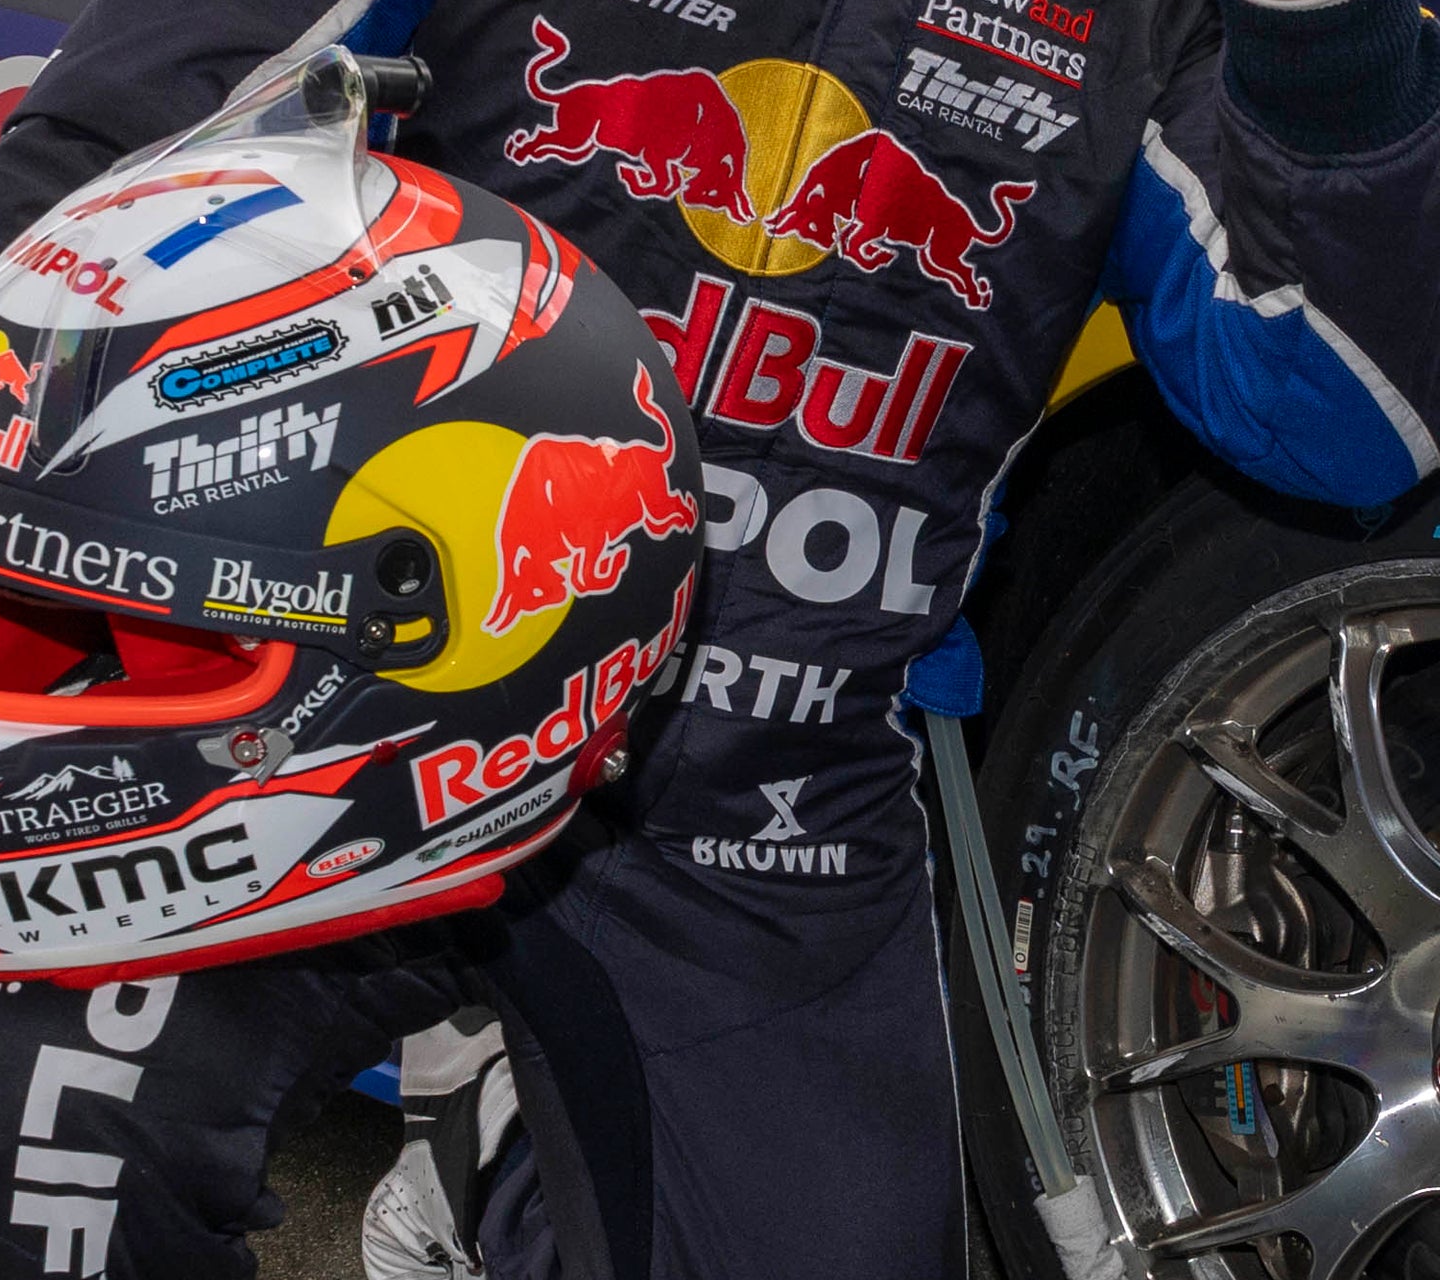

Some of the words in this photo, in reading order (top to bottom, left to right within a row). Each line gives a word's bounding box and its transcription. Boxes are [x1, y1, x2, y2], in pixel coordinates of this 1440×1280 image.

[896, 46, 1080, 153] Thrifty
[896, 91, 936, 120] CAR
[937, 101, 1005, 142] RENTAL
[371, 263, 455, 331] nti
[707, 298, 973, 464] Bull
[143, 402, 342, 500] Thrifty
[153, 490, 200, 515] CAR
[204, 468, 290, 504] RENTAL
[701, 462, 937, 615] POL
[206, 556, 354, 616] Blygold
[202, 608, 273, 627] CORROSION
[275, 618, 348, 636] PROTECTION
[280, 664, 347, 736] OAKLEY
[24, 829, 61, 845] WOOD
[65, 822, 101, 839] FIRED
[104, 814, 148, 832] GRILLS
[455, 787, 554, 850] SHANNONS
[317, 843, 376, 874] BELL
[691, 836, 848, 875] BROWN
[19, 880, 263, 944] WHEELS
